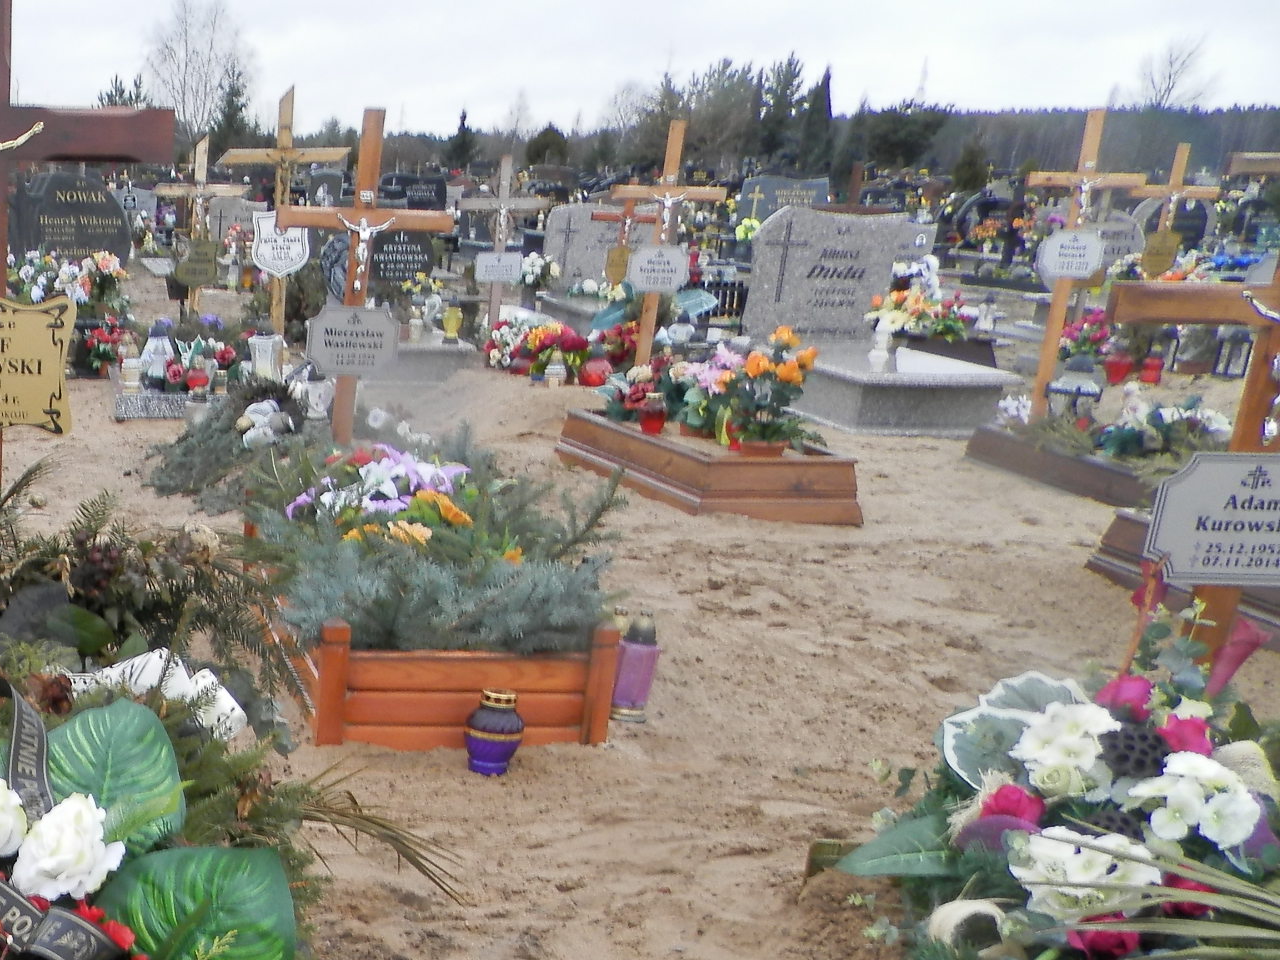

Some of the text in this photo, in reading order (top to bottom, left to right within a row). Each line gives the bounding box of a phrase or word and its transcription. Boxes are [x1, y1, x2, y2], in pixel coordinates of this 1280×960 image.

[56, 190, 107, 203] NOWAK
[39, 215, 122, 227] Henryk Wiktoria
[56, 245, 105, 256] Kazimie
[806, 264, 867, 280] Duda
[1223, 494, 1280, 511] Adam
